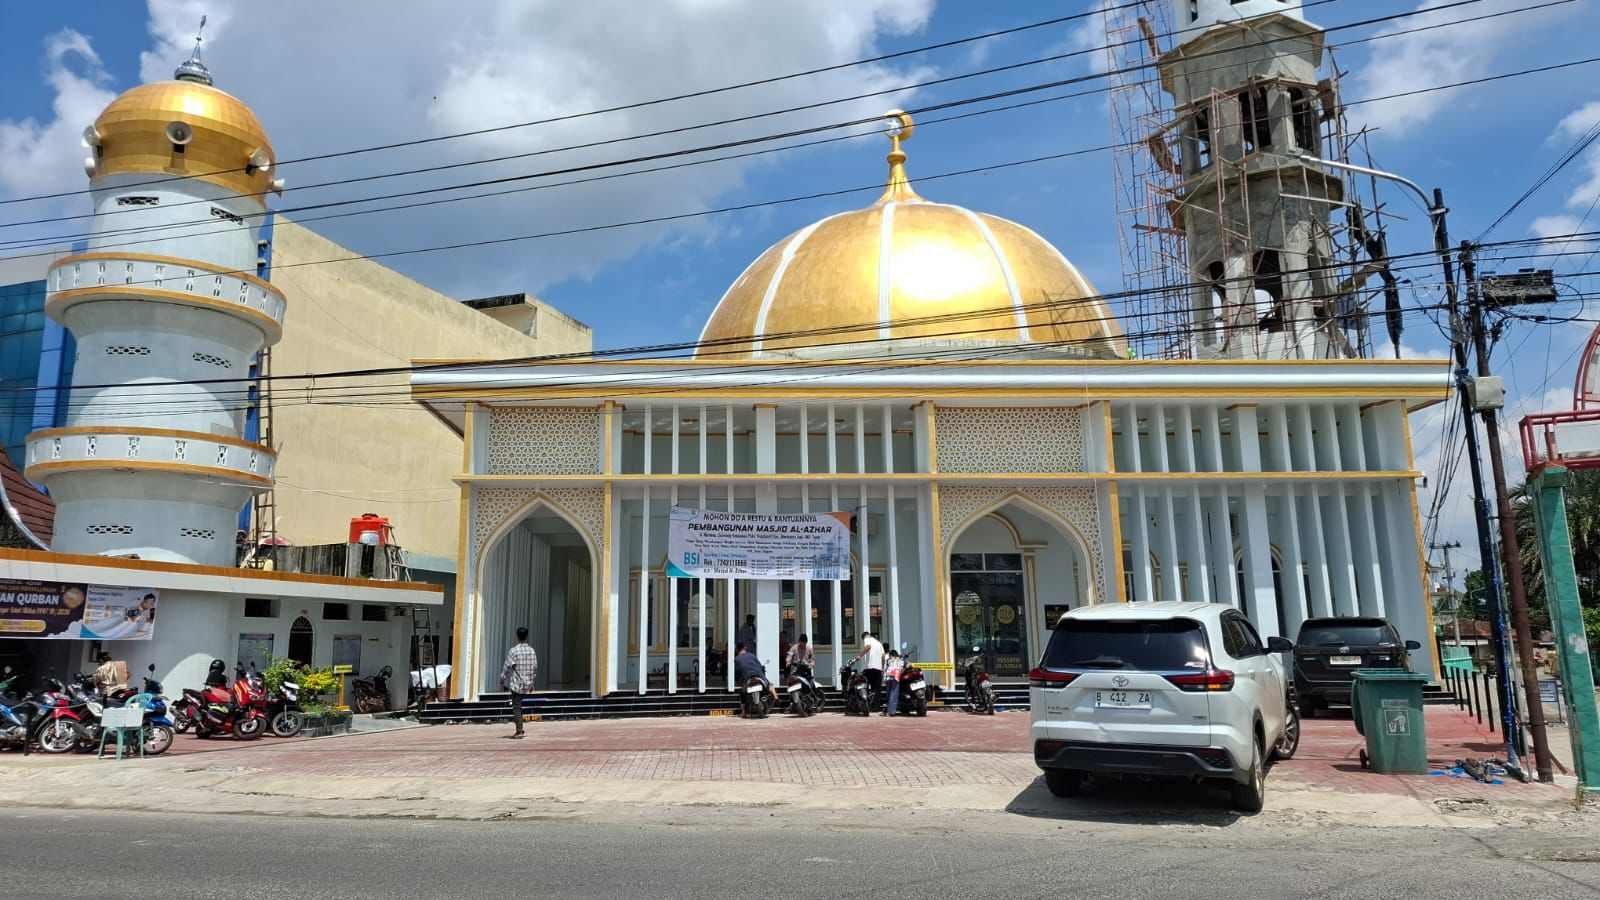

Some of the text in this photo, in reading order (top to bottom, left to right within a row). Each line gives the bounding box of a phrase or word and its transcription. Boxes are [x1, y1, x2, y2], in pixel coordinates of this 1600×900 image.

[703, 513, 729, 521] MOHON
[747, 514, 766, 522] RESTU
[688, 523, 753, 531] PEMBANGUNAN
[790, 525, 832, 534] AL-AZHAR
[684, 552, 700, 565] BSI
[17, 593, 60, 605] QURBAN
[1096, 692, 1150, 703] B 412 ZA
